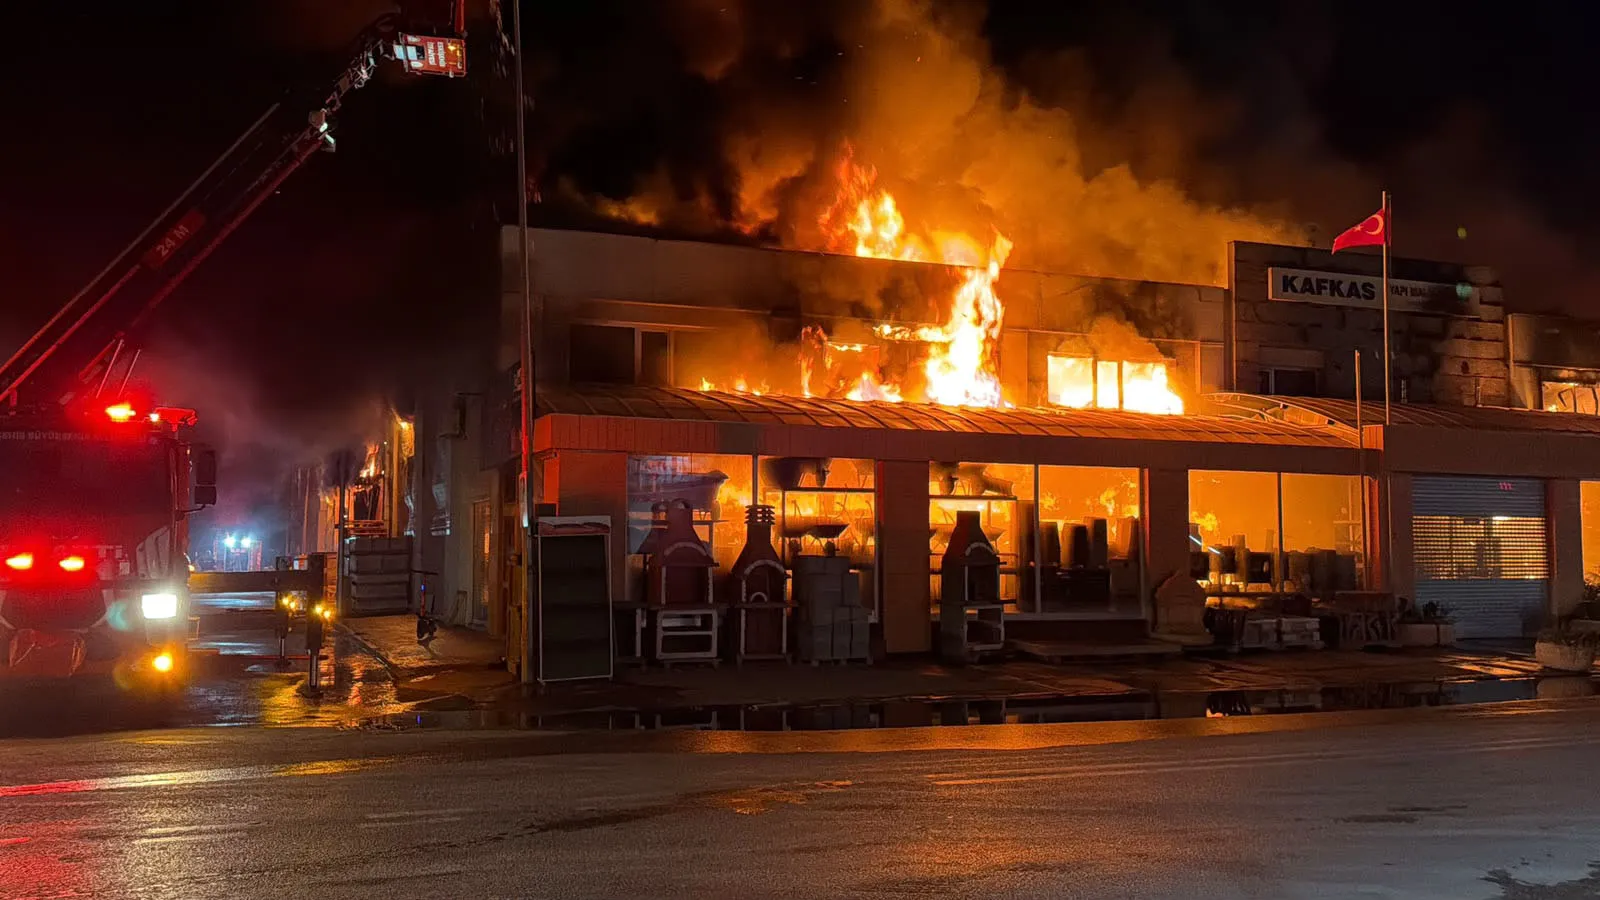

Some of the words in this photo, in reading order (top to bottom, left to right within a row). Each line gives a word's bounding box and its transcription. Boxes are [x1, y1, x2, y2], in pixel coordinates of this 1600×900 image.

[156, 237, 176, 257] 24
[173, 225, 189, 239] M
[1282, 275, 1376, 300] KAFKAS
